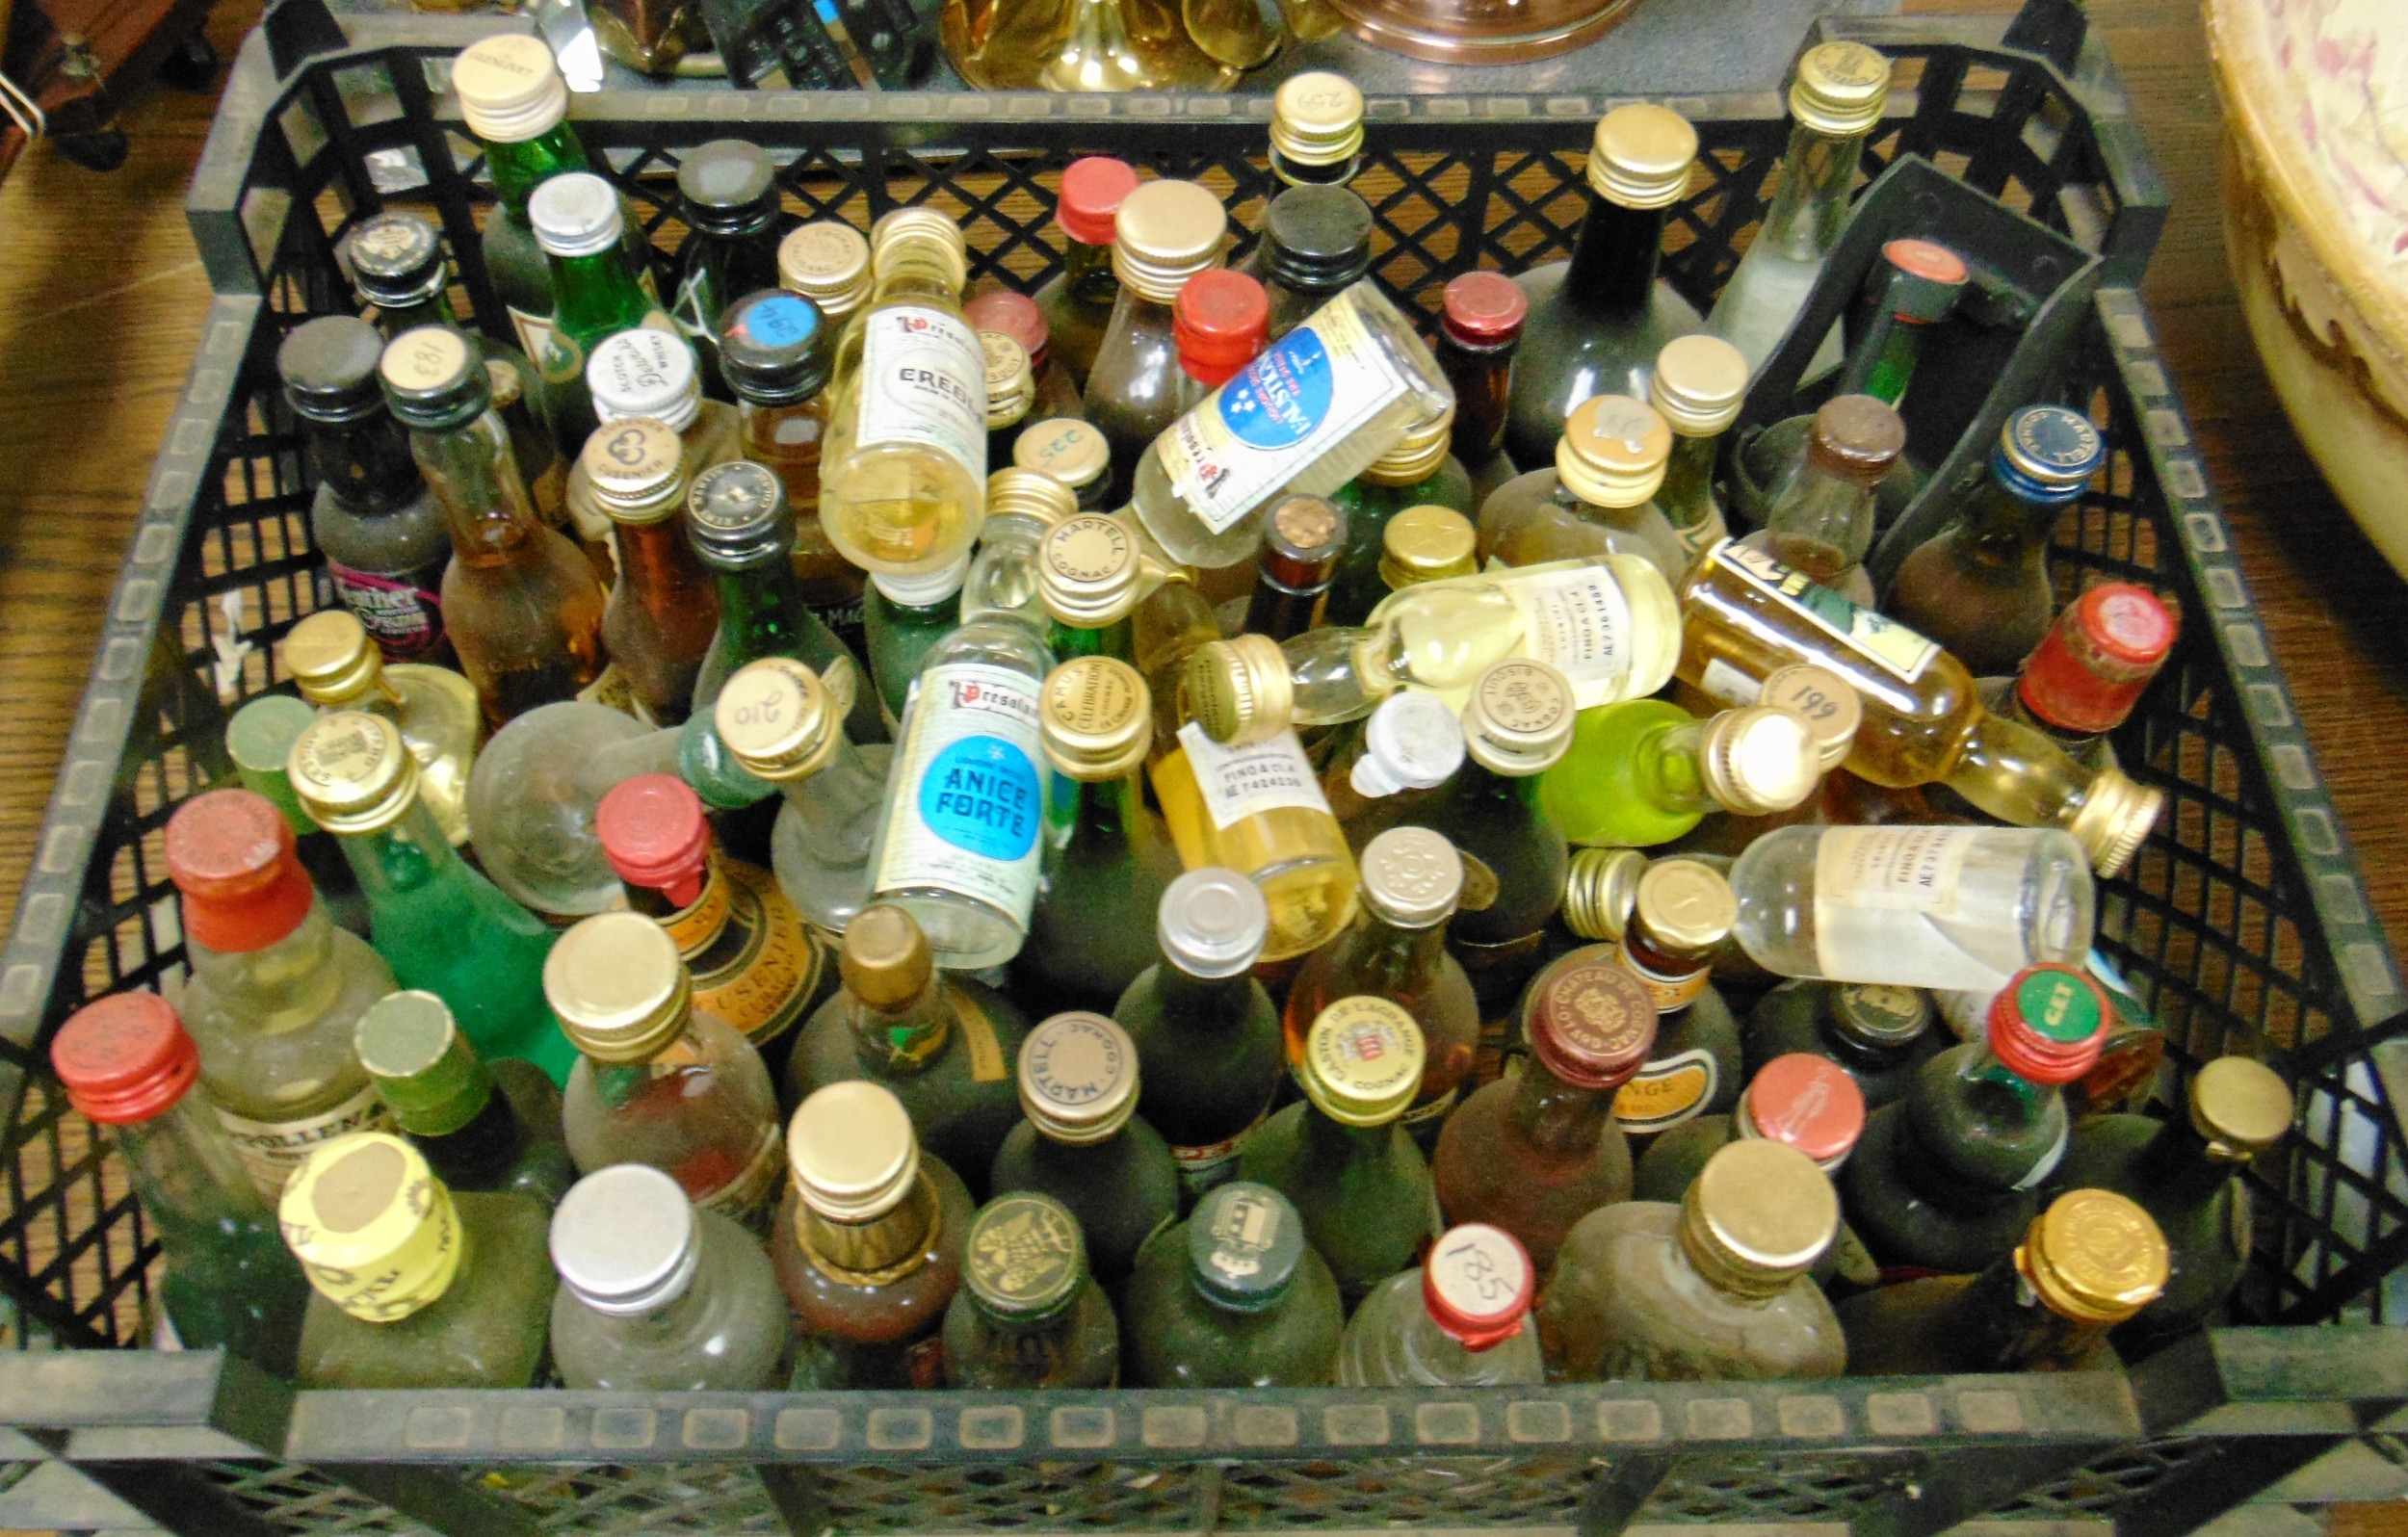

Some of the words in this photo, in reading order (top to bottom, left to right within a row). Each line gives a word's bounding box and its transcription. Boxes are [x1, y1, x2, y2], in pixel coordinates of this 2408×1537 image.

[1038, 429, 1085, 467] 225
[1057, 520, 1125, 556] MARTELL
[1053, 552, 1112, 578] COGNAC
[1054, 666, 1084, 722] CAMUS
[1790, 685, 1839, 721] 199
[944, 768, 1028, 811] ANICE
[935, 792, 1026, 838] FORTE
[1032, 1038, 1098, 1101] MARTELL
[1070, 1022, 1116, 1075] COGNAC
[1445, 1241, 1518, 1301] 185
